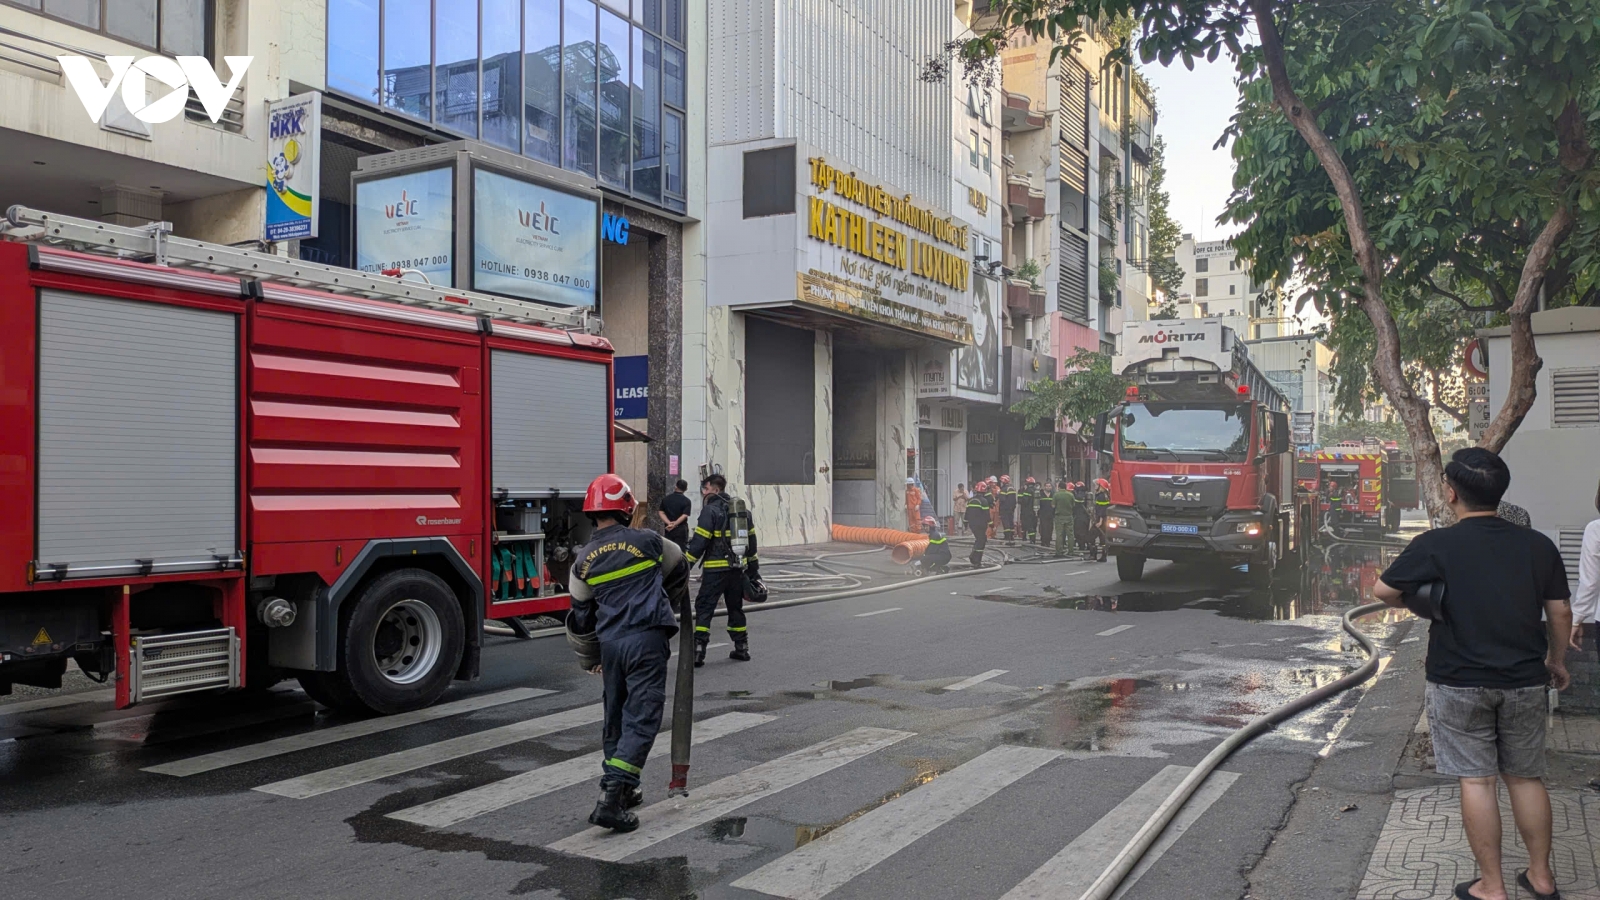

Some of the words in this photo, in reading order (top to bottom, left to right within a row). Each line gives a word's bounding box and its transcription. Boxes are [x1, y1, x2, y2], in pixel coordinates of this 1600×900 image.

[270, 117, 303, 138] HKK
[809, 157, 834, 193] TẬP
[834, 171, 866, 206] ĐOÀN
[867, 185, 891, 219] VIỆN
[935, 217, 956, 245] QUỐC
[955, 225, 968, 251] TẾ
[602, 212, 630, 246] NG
[516, 237, 538, 247] ELECTRICITY
[539, 242, 554, 250] SERVICE
[808, 195, 908, 271] KATHLEEN
[912, 238, 970, 292] LUXURY
[391, 260, 411, 269] 0938
[414, 258, 429, 267] 047
[432, 255, 448, 265] 000
[481, 260, 519, 276] HOTLINE:
[524, 268, 549, 281] 0938
[553, 274, 570, 285] 047
[574, 278, 590, 289] 000
[840, 256, 858, 276] Nơi
[859, 262, 874, 281] thế
[875, 270, 892, 289] giới
[893, 275, 915, 296] ngắm
[917, 283, 932, 301] nhìn
[879, 301, 894, 317] KHOA
[1138, 330, 1205, 343] MORITA
[924, 372, 945, 382] mymy
[616, 387, 649, 399] LEASE
[614, 408, 624, 416] 67
[941, 407, 963, 429] mymy
[969, 432, 995, 444] mymy
[1159, 492, 1201, 501] MAN
[427, 517, 462, 525] rosenbauer
[599, 543, 617, 554] PCCC
